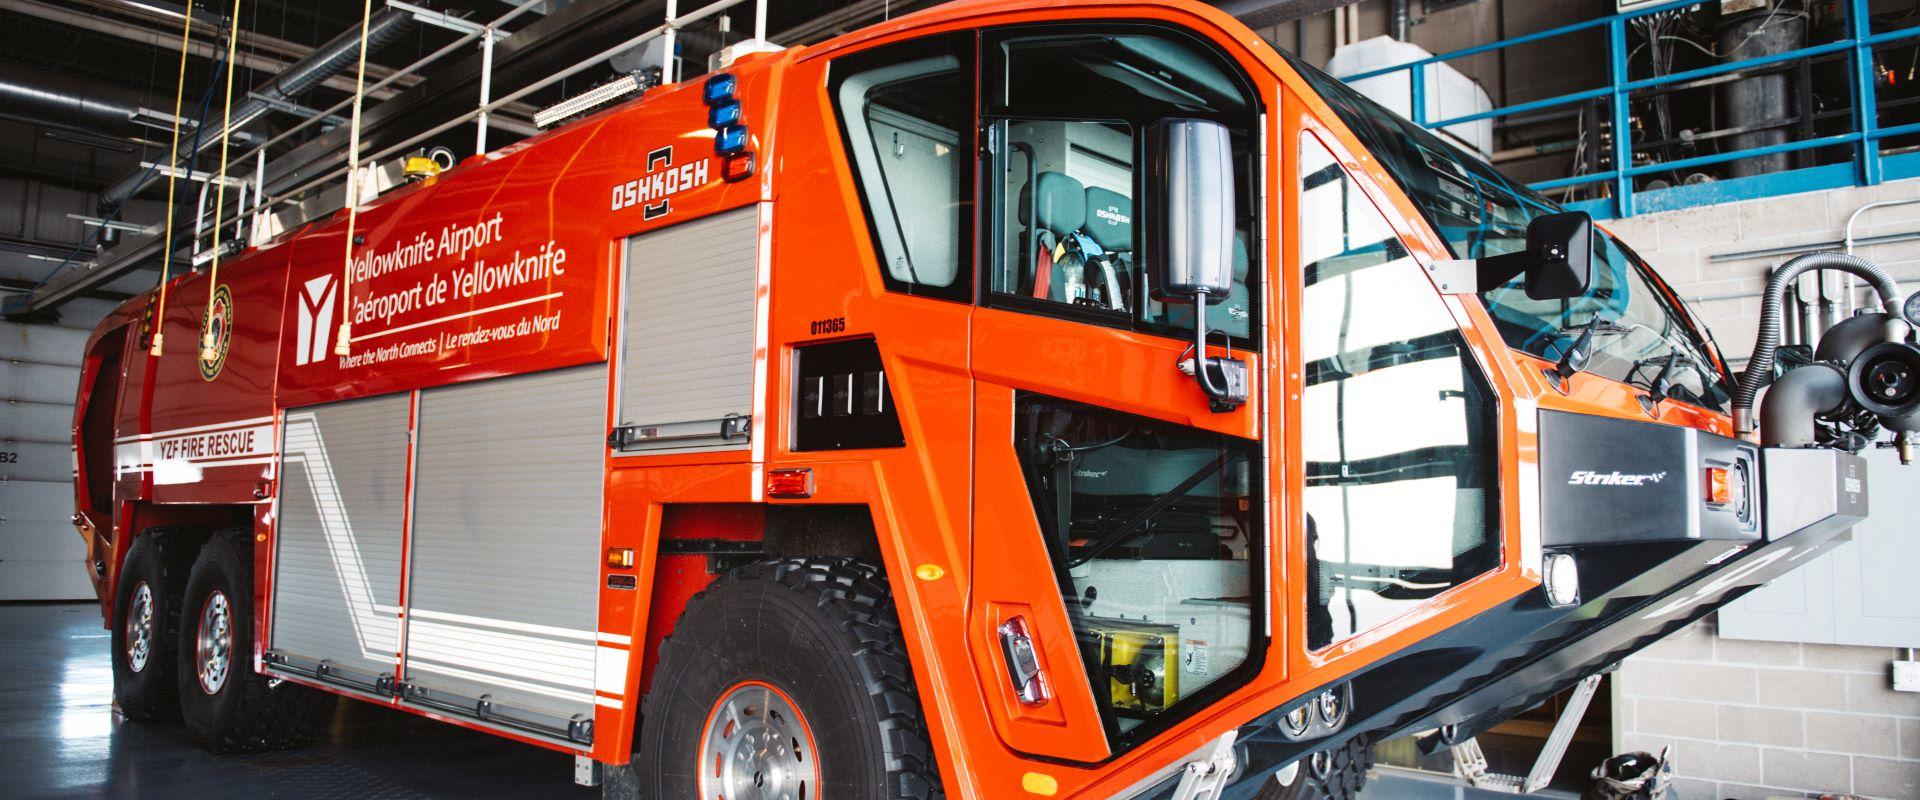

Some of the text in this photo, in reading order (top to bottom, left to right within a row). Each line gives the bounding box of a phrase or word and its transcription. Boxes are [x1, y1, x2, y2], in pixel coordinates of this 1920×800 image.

[611, 158, 709, 211] OSHKOSH
[350, 211, 503, 284] Yellowknife Airport
[350, 241, 566, 325] 'aéroport de Yellowknife
[339, 311, 561, 370] Where the North Connects Le rendez-vous du Nord
[810, 317, 846, 335] 011365
[160, 430, 254, 460] YZF FIRE RESCUE
[1567, 471, 1646, 486] Striker
